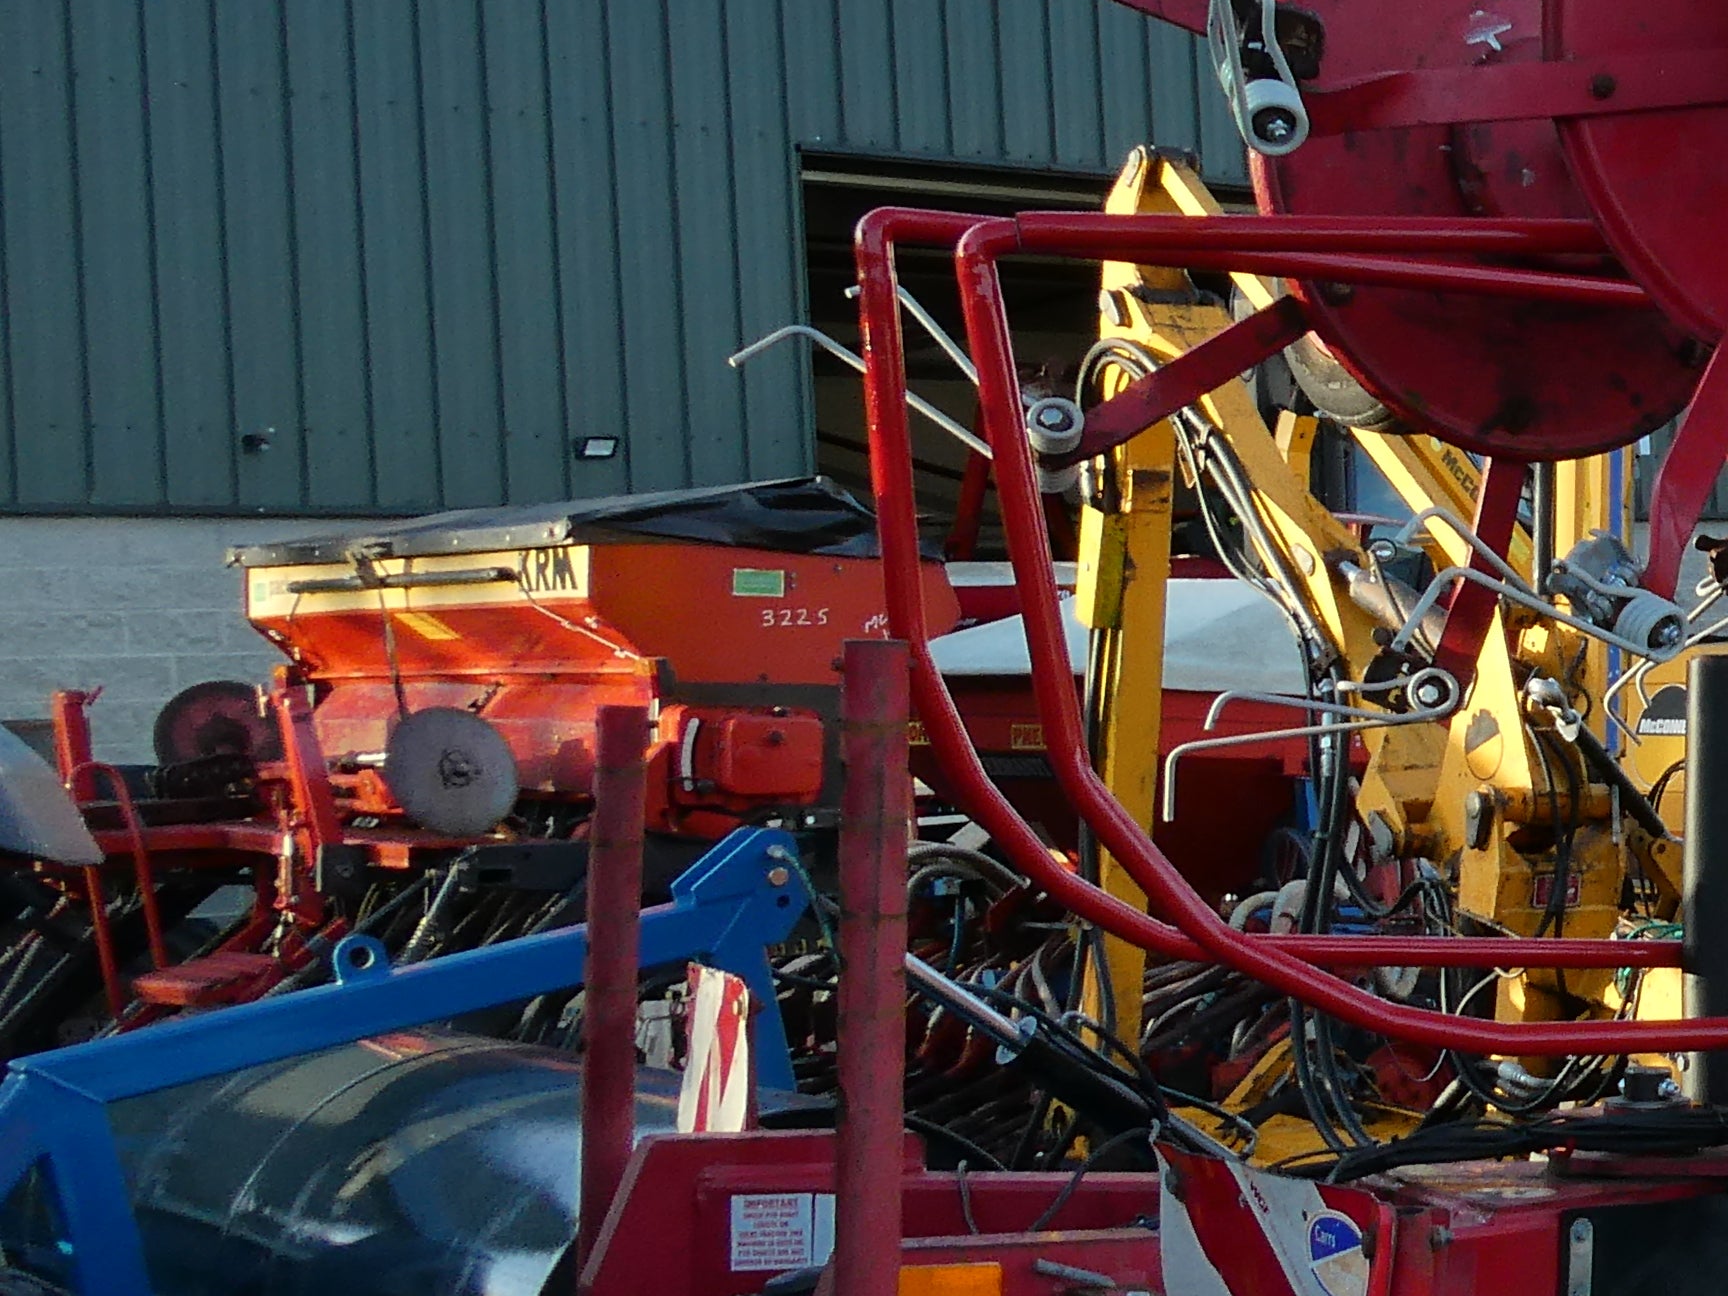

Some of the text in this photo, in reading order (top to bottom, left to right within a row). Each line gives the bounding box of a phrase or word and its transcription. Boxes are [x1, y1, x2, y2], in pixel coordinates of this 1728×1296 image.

[1441, 448, 1480, 503] McCO
[519, 548, 578, 592] KRM
[762, 608, 829, 627] 3225
[1639, 718, 1687, 734] McCONN
